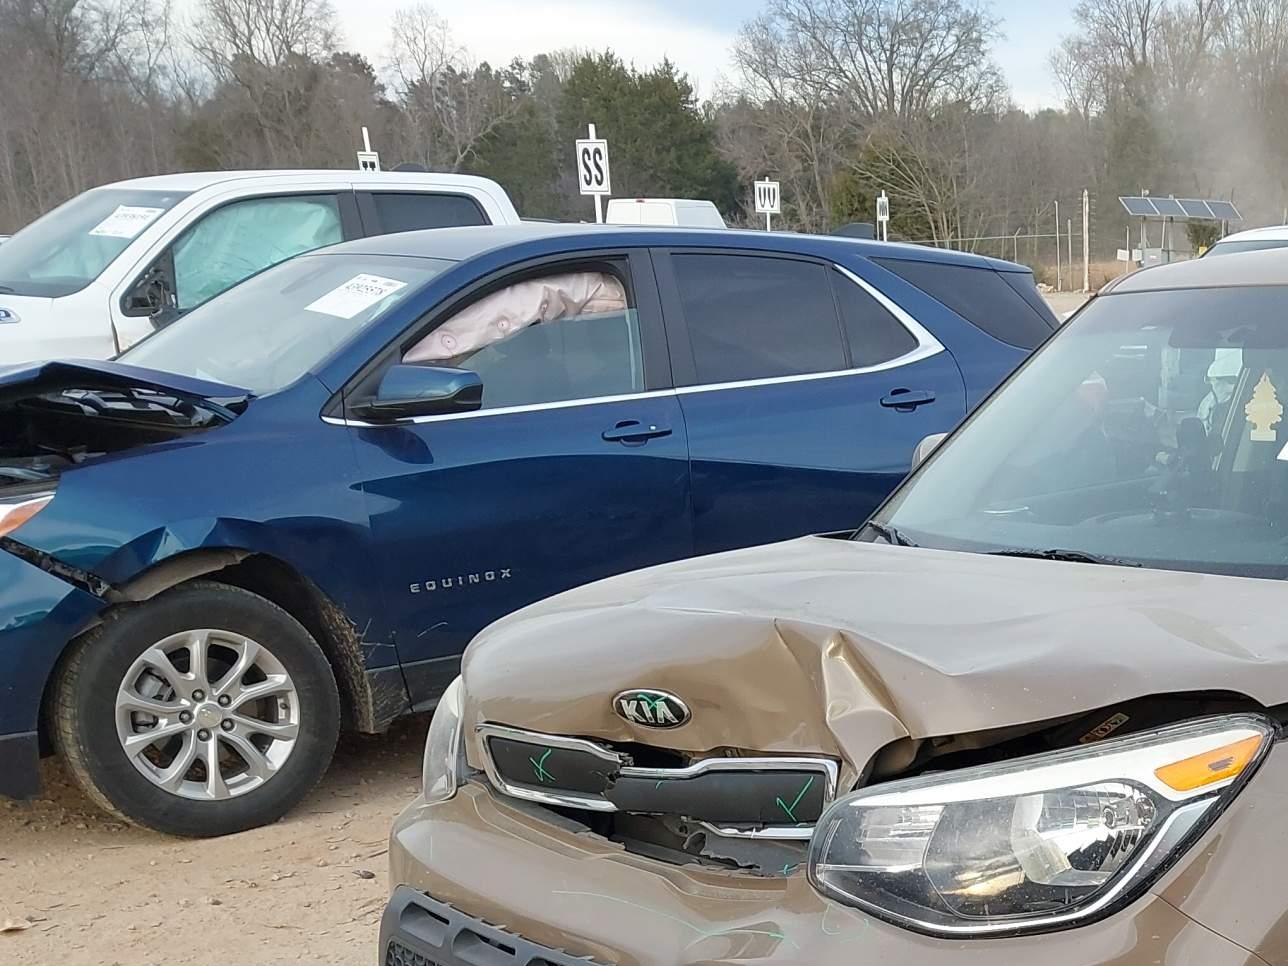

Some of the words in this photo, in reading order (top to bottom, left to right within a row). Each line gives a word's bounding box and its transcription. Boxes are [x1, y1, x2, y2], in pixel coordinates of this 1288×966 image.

[581, 147, 604, 186] SS
[409, 568, 512, 593] EQUINOX
[620, 699, 680, 724] KIA
